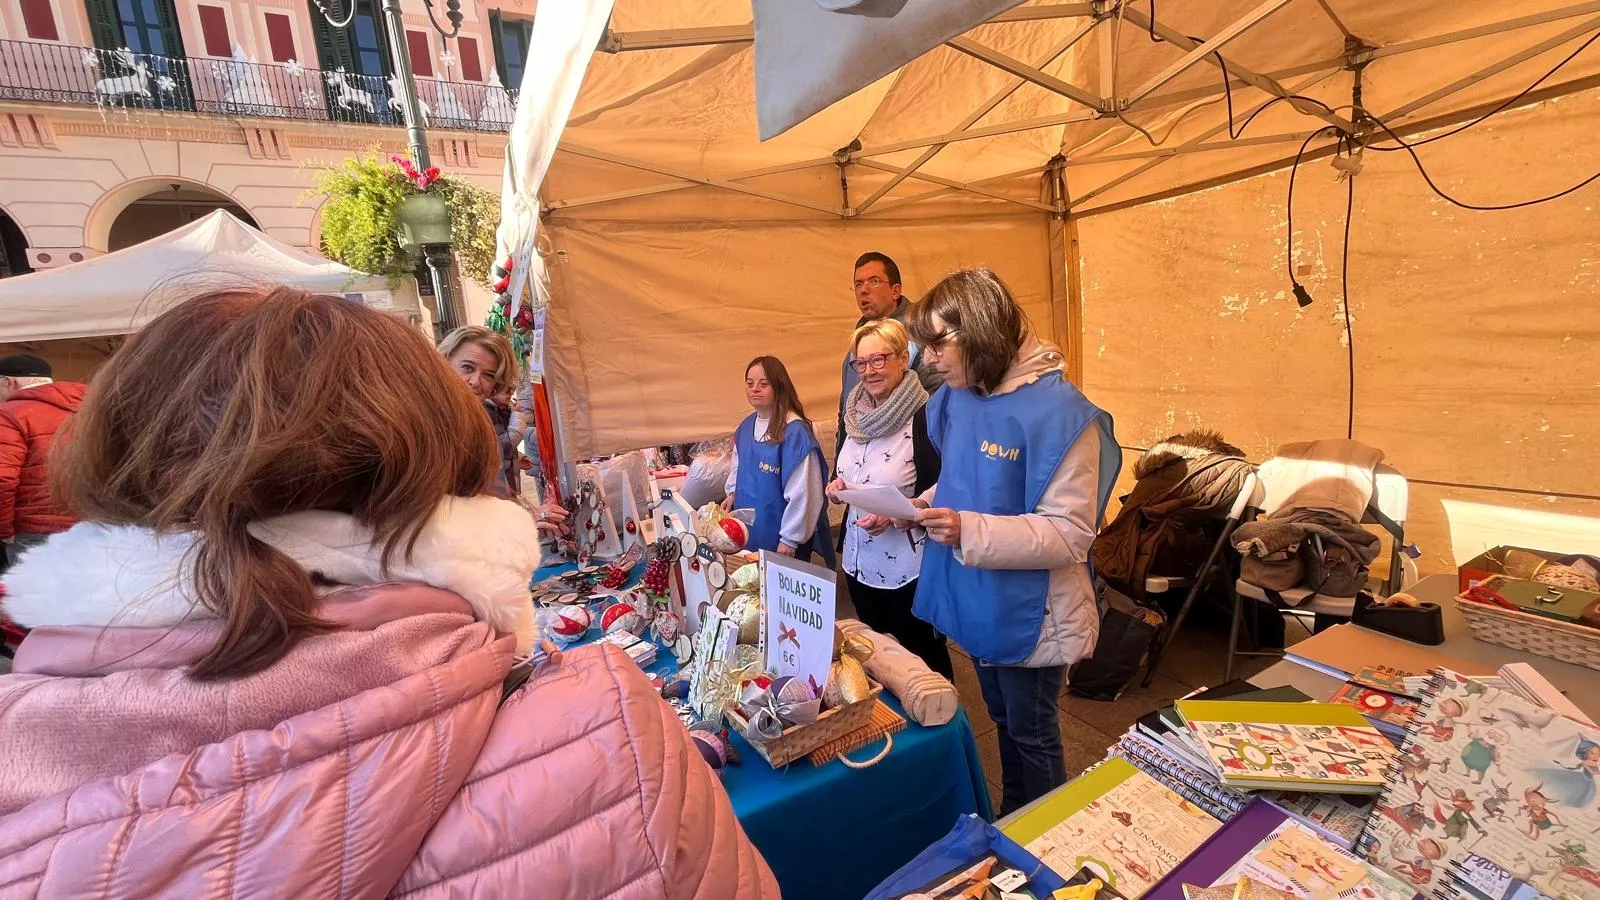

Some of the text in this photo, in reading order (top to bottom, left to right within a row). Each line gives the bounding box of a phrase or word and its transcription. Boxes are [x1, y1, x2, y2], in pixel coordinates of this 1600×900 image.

[980, 439, 1020, 462] DOWN
[758, 461, 781, 475] DOWN
[778, 572, 822, 605] BOLAS DE
[778, 595, 823, 631] NAVIDAD
[783, 650, 795, 667] 6€
